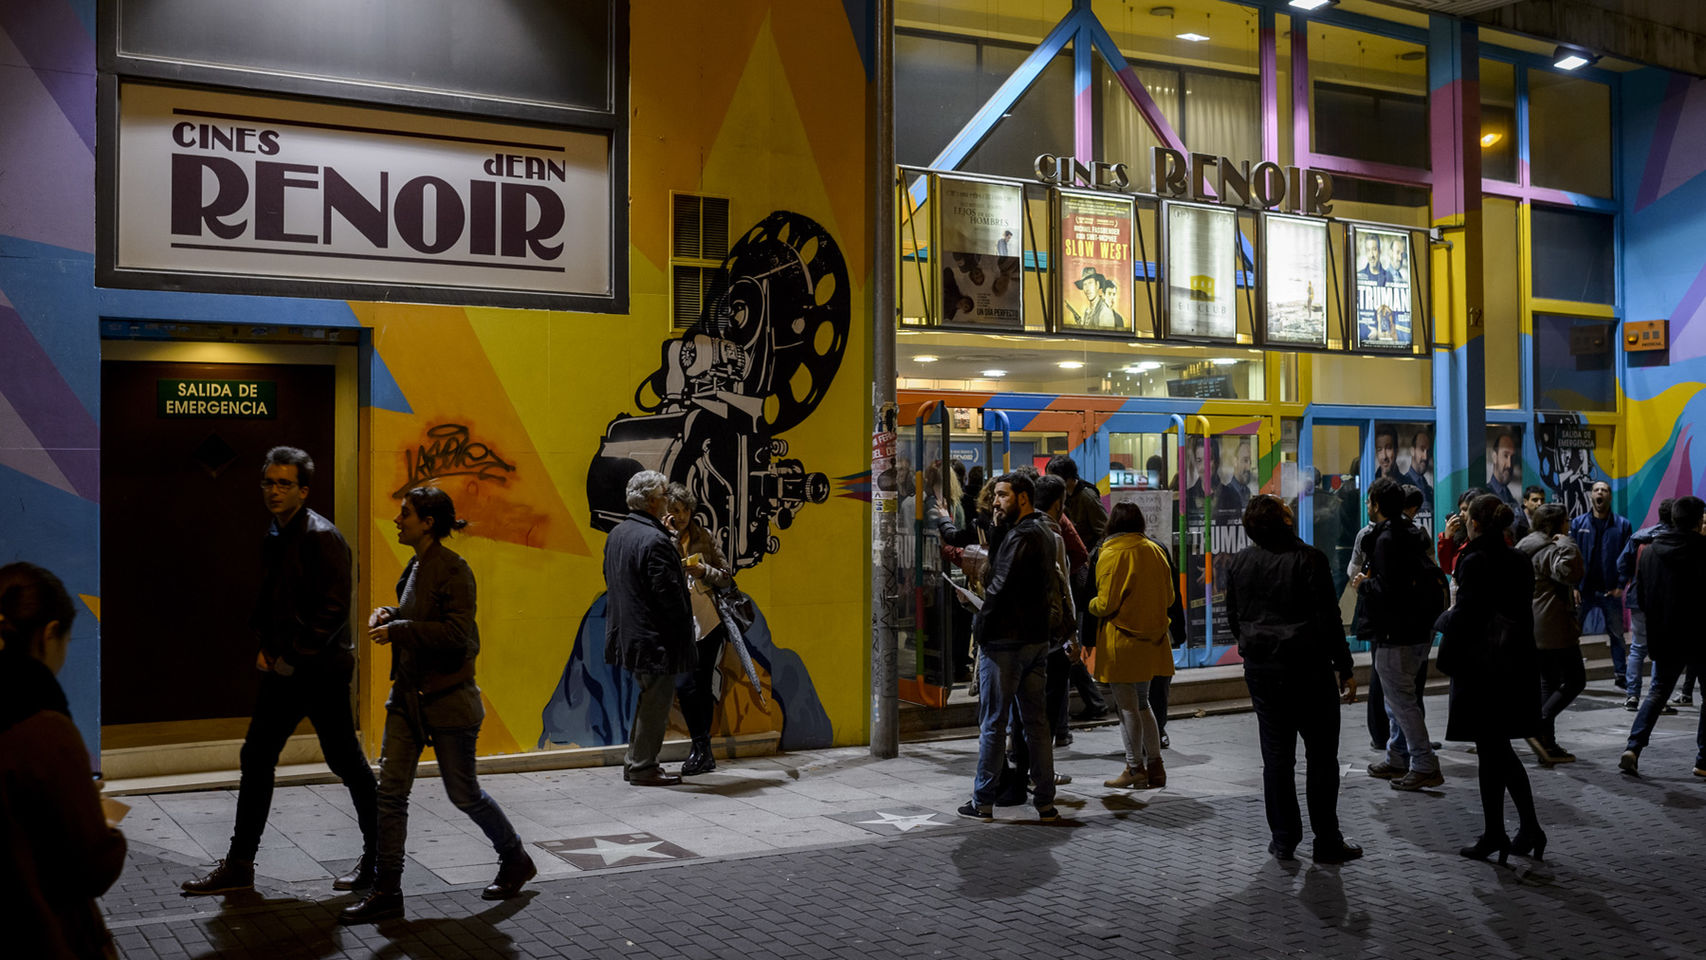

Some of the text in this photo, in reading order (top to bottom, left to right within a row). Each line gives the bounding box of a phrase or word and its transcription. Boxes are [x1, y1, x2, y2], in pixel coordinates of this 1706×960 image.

[172, 121, 281, 156] CINES
[1034, 146, 1334, 215] CINES RENOIR
[171, 152, 566, 261] RENOIR
[1065, 238, 1129, 261] SLOW WEST
[1199, 302, 1227, 313] CLUB
[1357, 286, 1410, 312] TRUMAN
[178, 382, 258, 398] SALIDA DE
[166, 400, 268, 415] EMERGENCIA
[1557, 438, 1595, 449] EMERGENCIA
